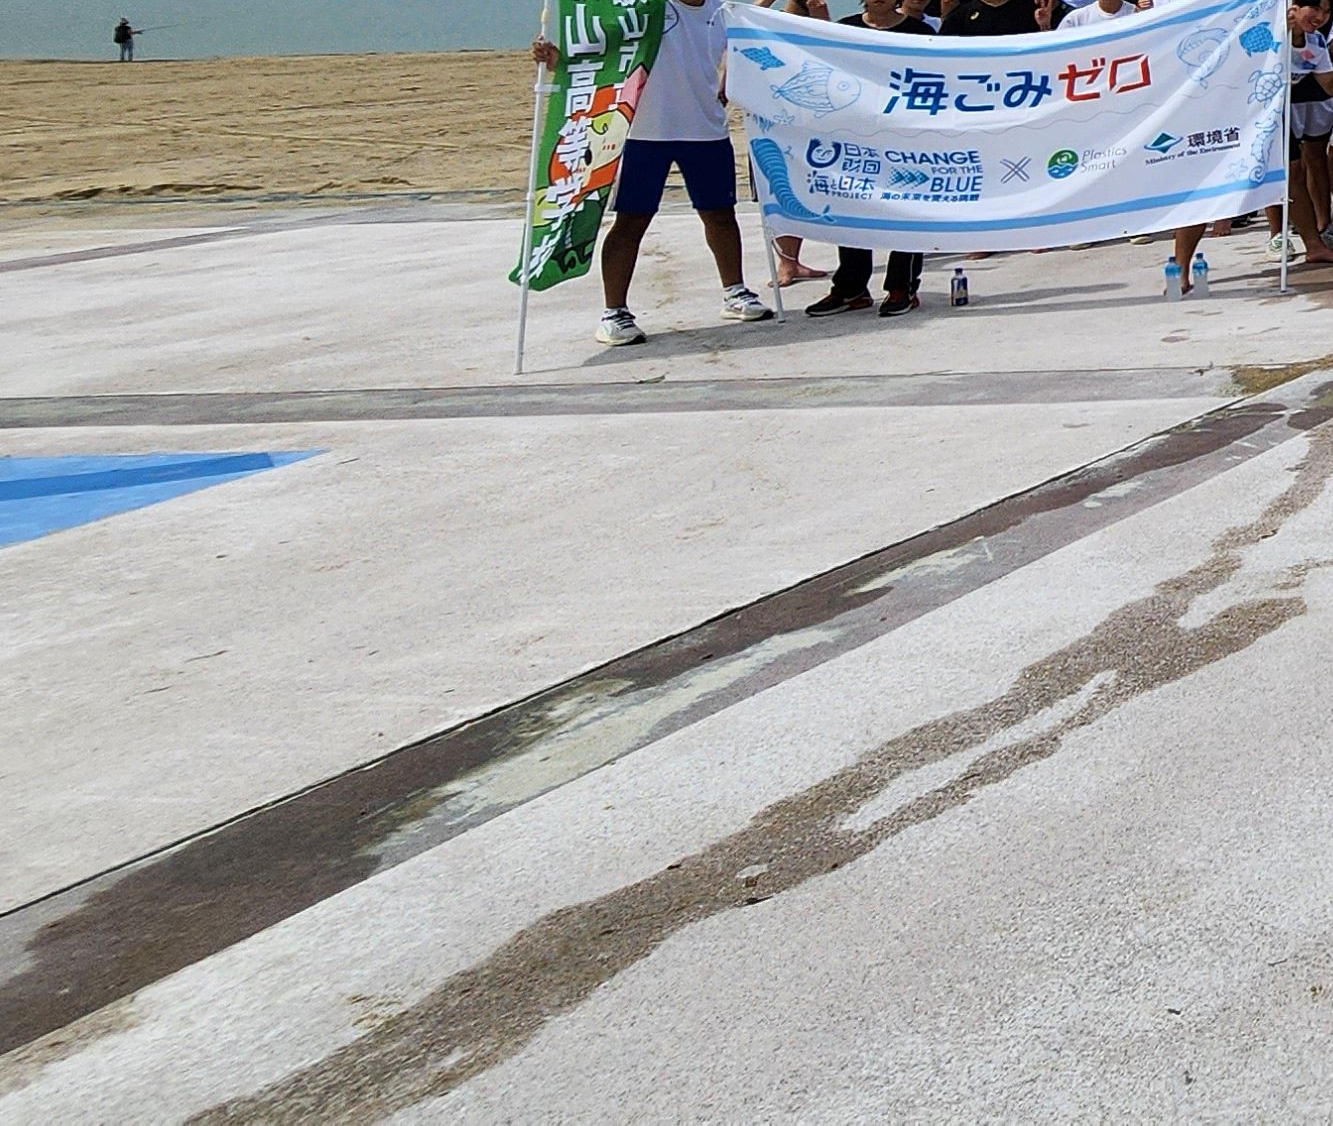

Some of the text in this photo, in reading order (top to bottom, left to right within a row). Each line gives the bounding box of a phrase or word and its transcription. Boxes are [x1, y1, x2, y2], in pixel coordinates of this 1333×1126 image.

[882, 54, 1152, 116] 海ごみゼロ
[1187, 127, 1241, 148] 環境省
[844, 142, 880, 158] 日本
[884, 150, 981, 165] CHANGE
[1082, 146, 1127, 162] Plastics
[842, 158, 881, 175] 財団
[1080, 159, 1117, 173] Smart
[1145, 153, 1176, 166] Ministry
[931, 164, 983, 175] FOR THE
[930, 175, 983, 193] BLUE
